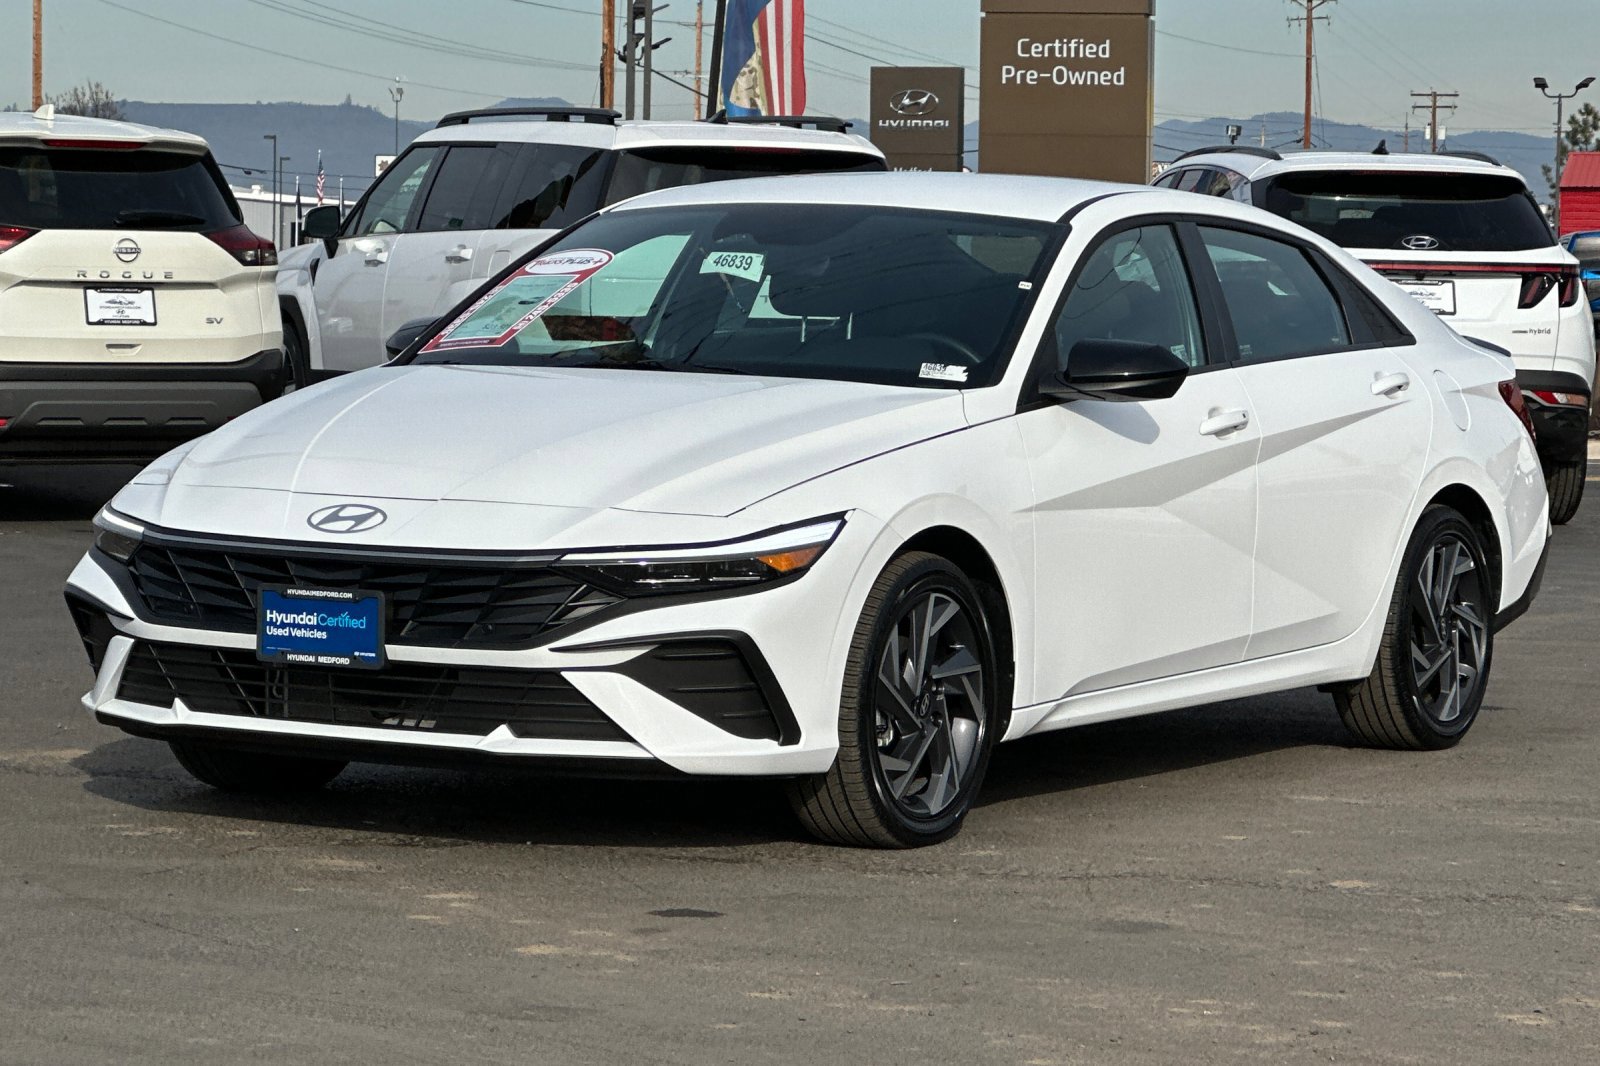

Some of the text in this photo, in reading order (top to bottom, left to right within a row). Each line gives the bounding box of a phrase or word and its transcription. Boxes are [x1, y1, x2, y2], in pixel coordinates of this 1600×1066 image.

[1017, 38, 1110, 58] Certified
[1001, 65, 1125, 85] Pre-Owned
[713, 254, 753, 271] 46839
[77, 270, 173, 279] ROGUE
[205, 317, 224, 325] SV
[287, 588, 353, 599] HYUNDAIMEDFORD.COM
[266, 609, 366, 629] Hyundai Certified
[266, 625, 327, 639] Used Vehicles
[287, 653, 350, 665] HYUNDAI MEDFORD
